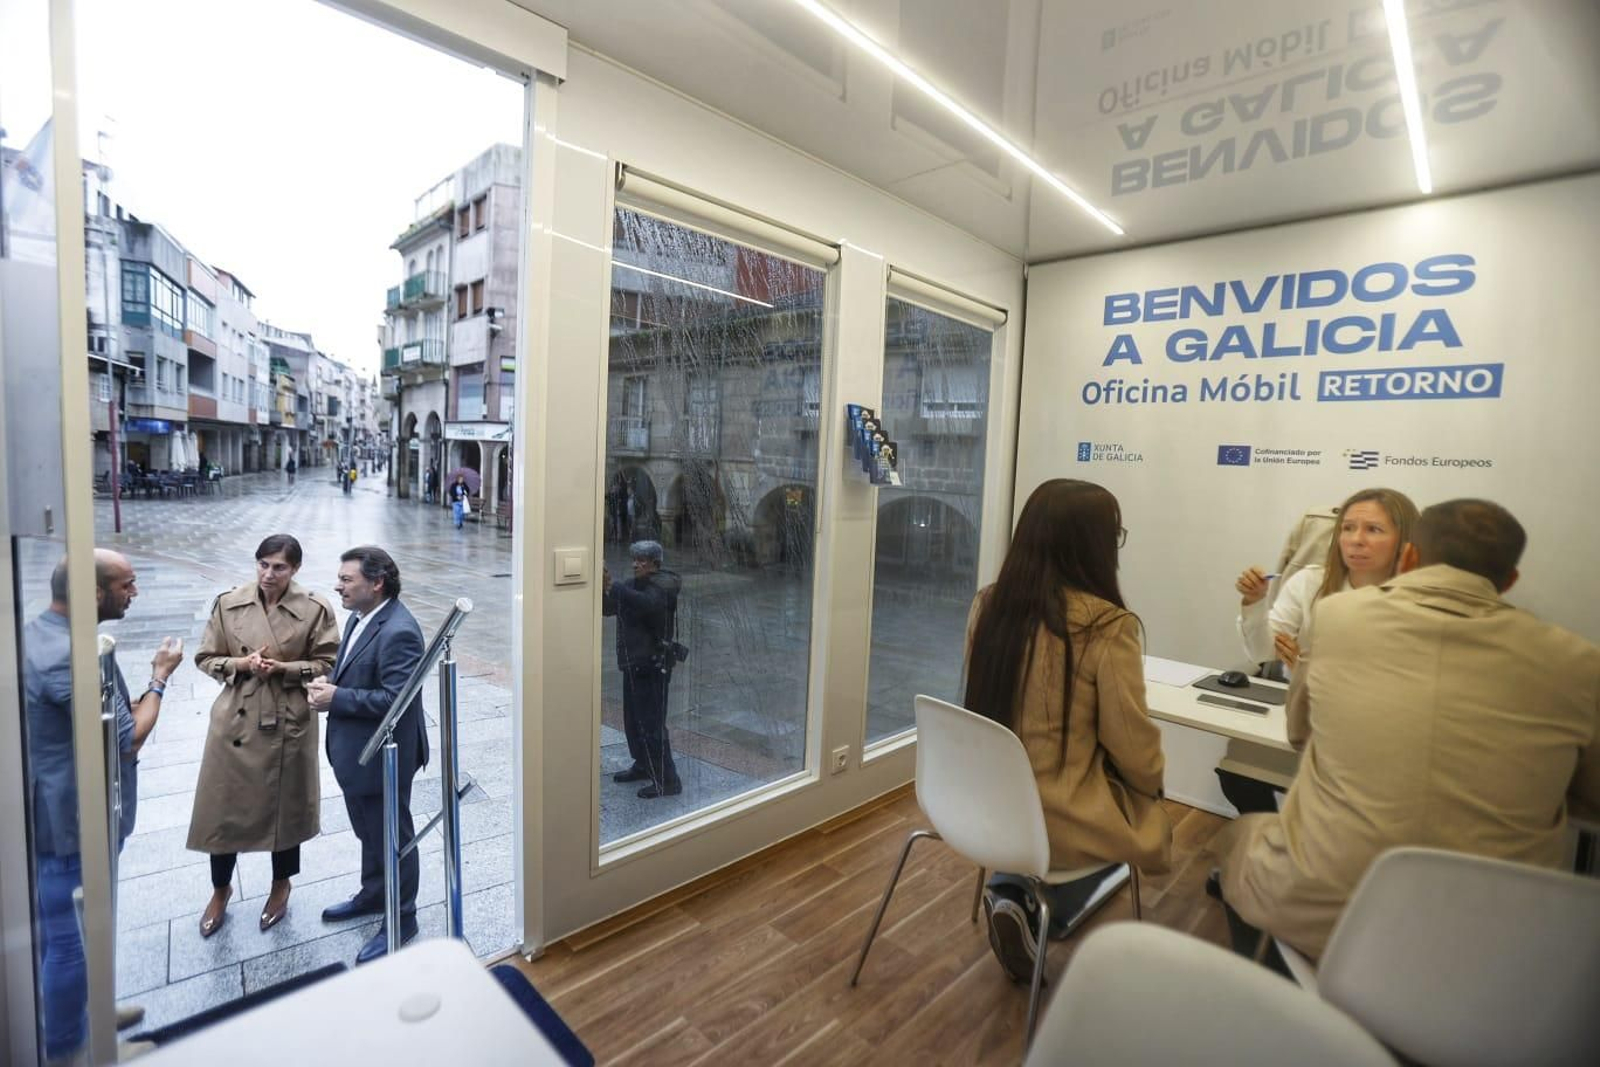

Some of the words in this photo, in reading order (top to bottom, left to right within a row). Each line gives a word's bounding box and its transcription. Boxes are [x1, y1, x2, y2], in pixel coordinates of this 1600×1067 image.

[1103, 254, 1476, 327] BENVIDOS
[1102, 334, 1143, 367] A
[1165, 308, 1464, 363] GALICIA
[1082, 378, 1188, 405] Oficina
[1200, 372, 1301, 403] Móbil
[1323, 368, 1494, 397] RETORNO
[1094, 443, 1124, 452] XUNTA
[1255, 448, 1305, 456] Cofinanciado
[1307, 450, 1322, 458] por
[1092, 452, 1104, 461] DE
[1106, 453, 1144, 462] GALICIA
[1286, 457, 1320, 466] Europea
[1385, 455, 1428, 467] Fondos
[1431, 456, 1492, 468] Europeos
